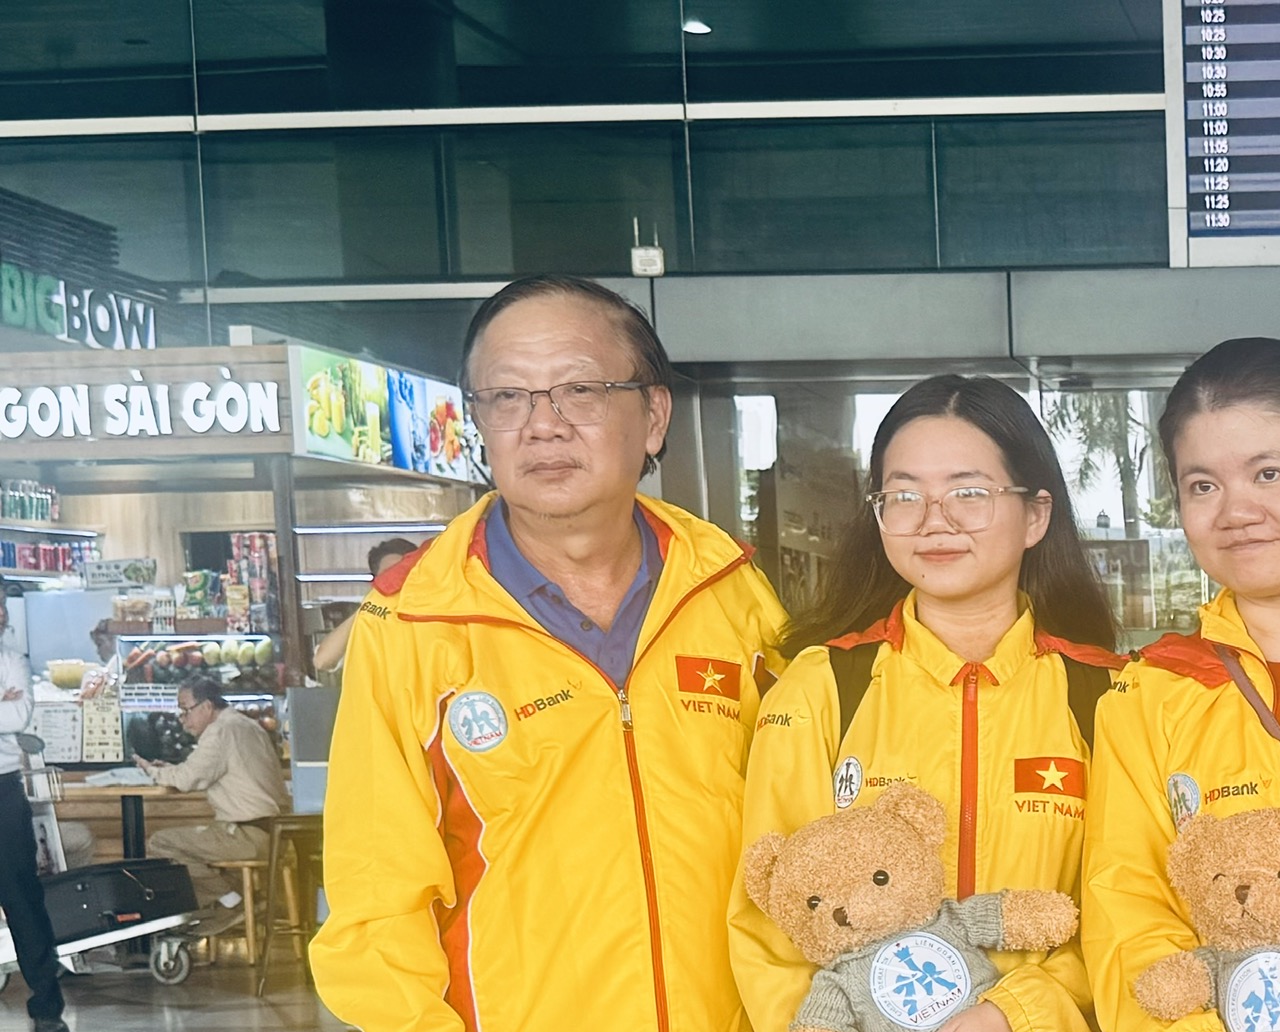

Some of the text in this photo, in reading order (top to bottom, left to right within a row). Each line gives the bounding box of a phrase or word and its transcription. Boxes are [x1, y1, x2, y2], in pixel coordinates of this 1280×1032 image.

[1201, 9, 1225, 23] 10:25
[1201, 27, 1226, 42] 10:25
[1201, 46, 1226, 60] 10:30
[1202, 64, 1226, 79] 10:30
[1202, 83, 1227, 97] 10:55
[1203, 101, 1227, 117] 11:00
[1203, 120, 1228, 135] 11:00
[1204, 138, 1228, 153] 11:05
[1204, 157, 1229, 172] 11:20
[1204, 175, 1229, 190] 11:25
[1205, 194, 1230, 209] 11:25
[1205, 212, 1230, 227] 11:30
[1, 261, 67, 337] BIG
[104, 368, 173, 436] SÀI
[181, 366, 280, 433] GÒN
[514, 689, 574, 722] HDBank
[681, 699, 741, 723] VIET NAM
[1204, 782, 1259, 805] HDBank
[1015, 800, 1085, 821] VIET NAM
[909, 987, 963, 1024] VIETNAM
